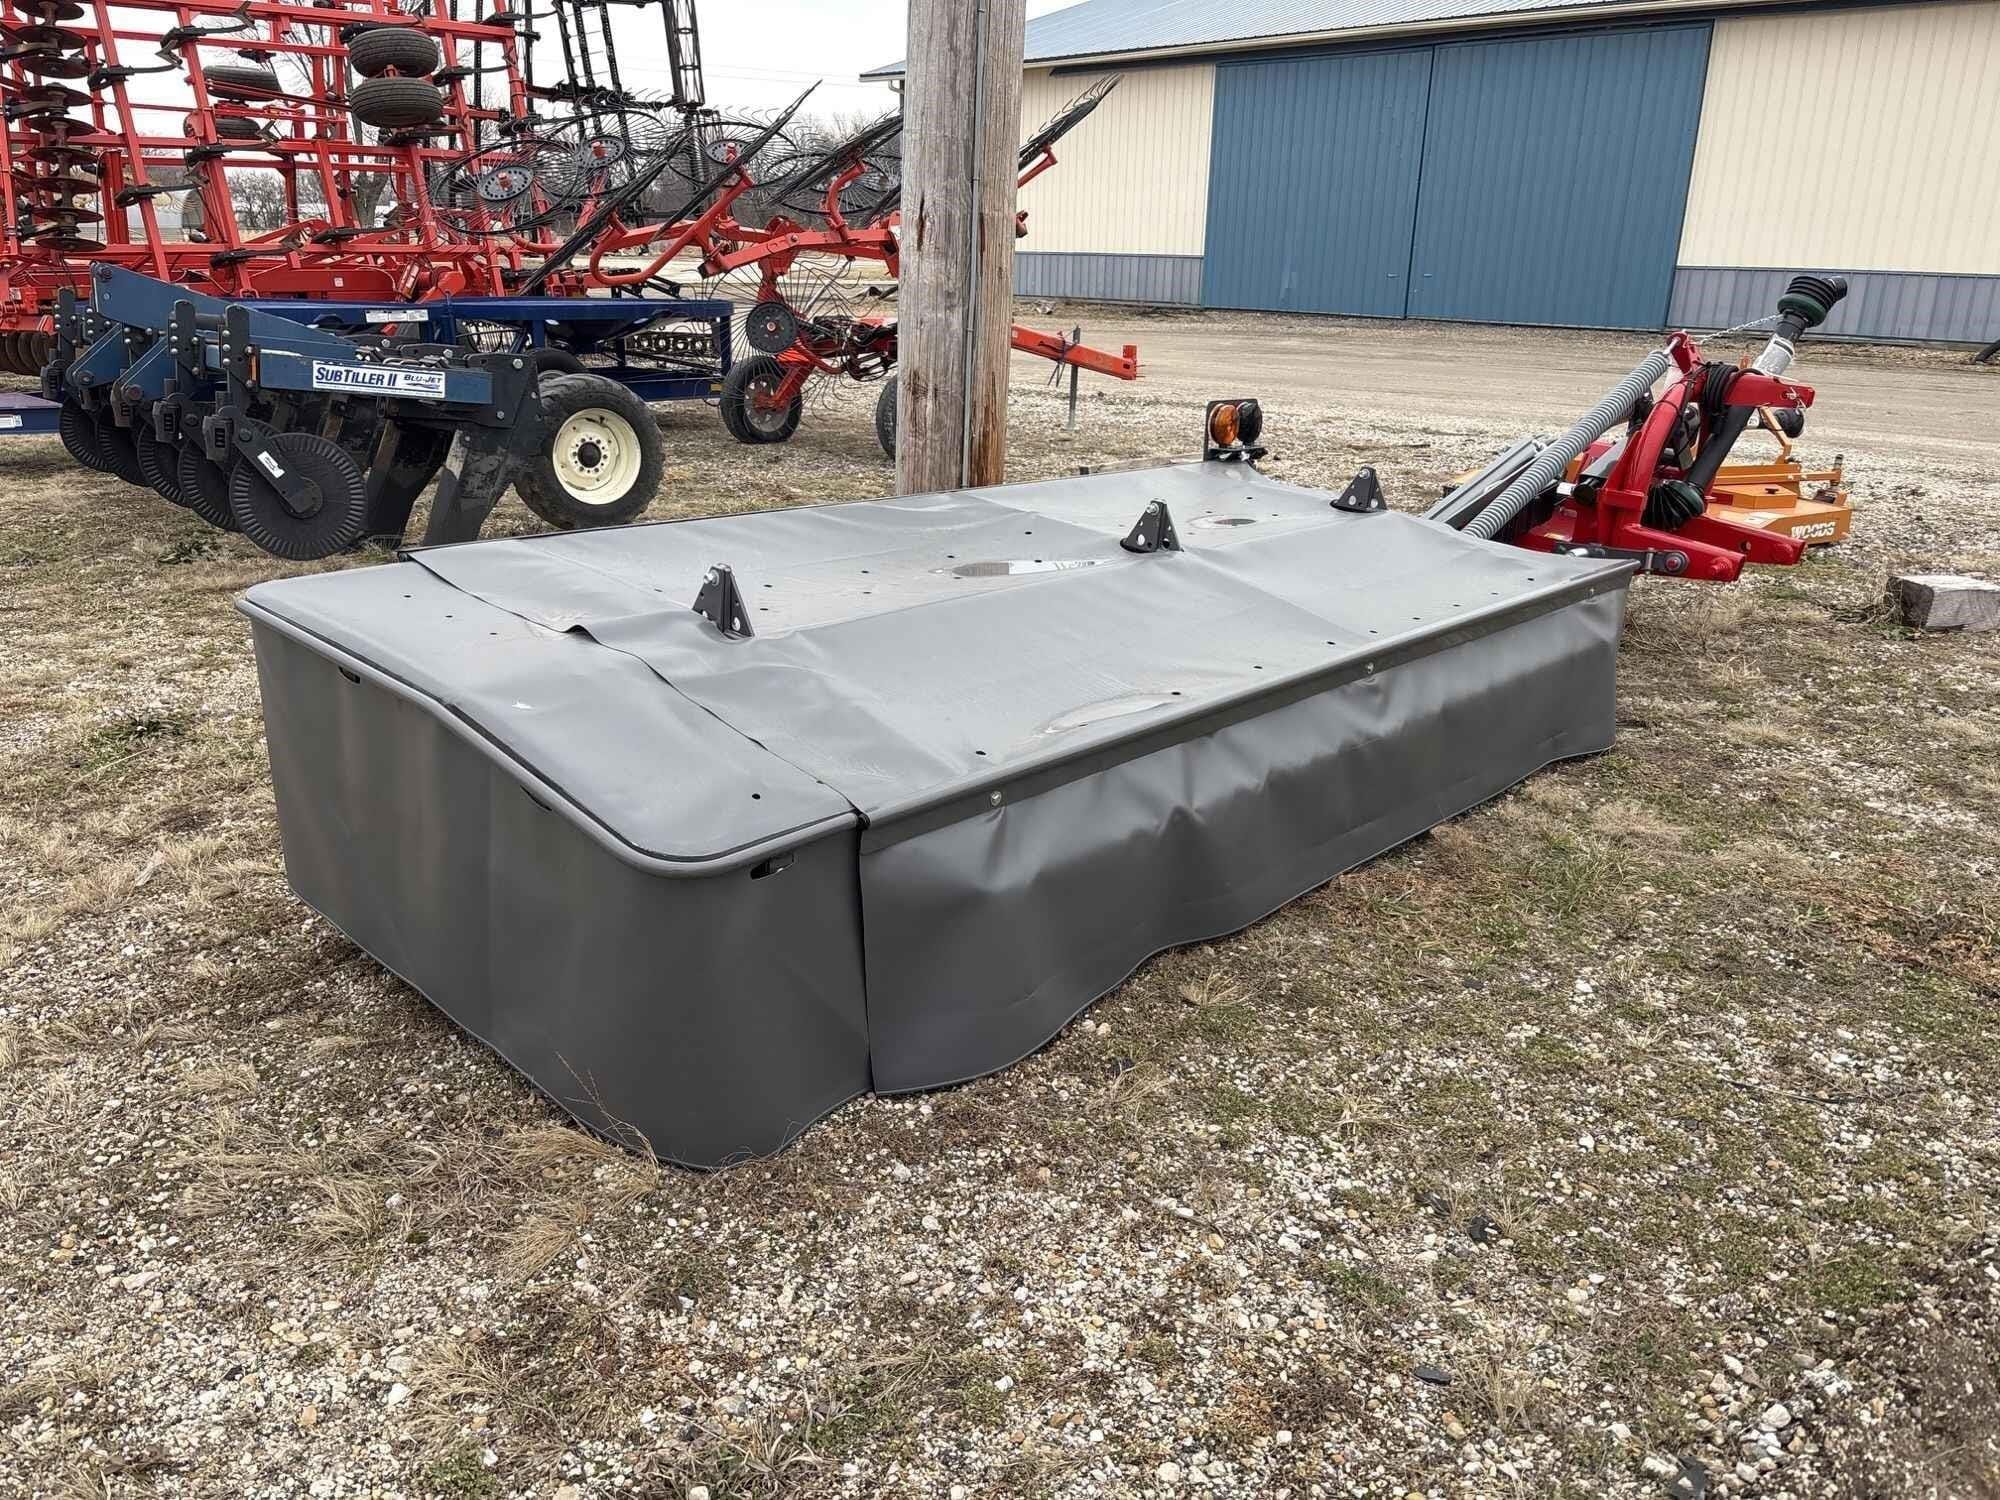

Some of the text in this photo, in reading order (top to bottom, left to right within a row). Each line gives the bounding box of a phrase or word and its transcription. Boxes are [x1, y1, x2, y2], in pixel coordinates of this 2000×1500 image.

[387, 373, 398, 387] II
[403, 374, 441, 384] BLU-JET
[1791, 522, 1836, 539] WOODS
